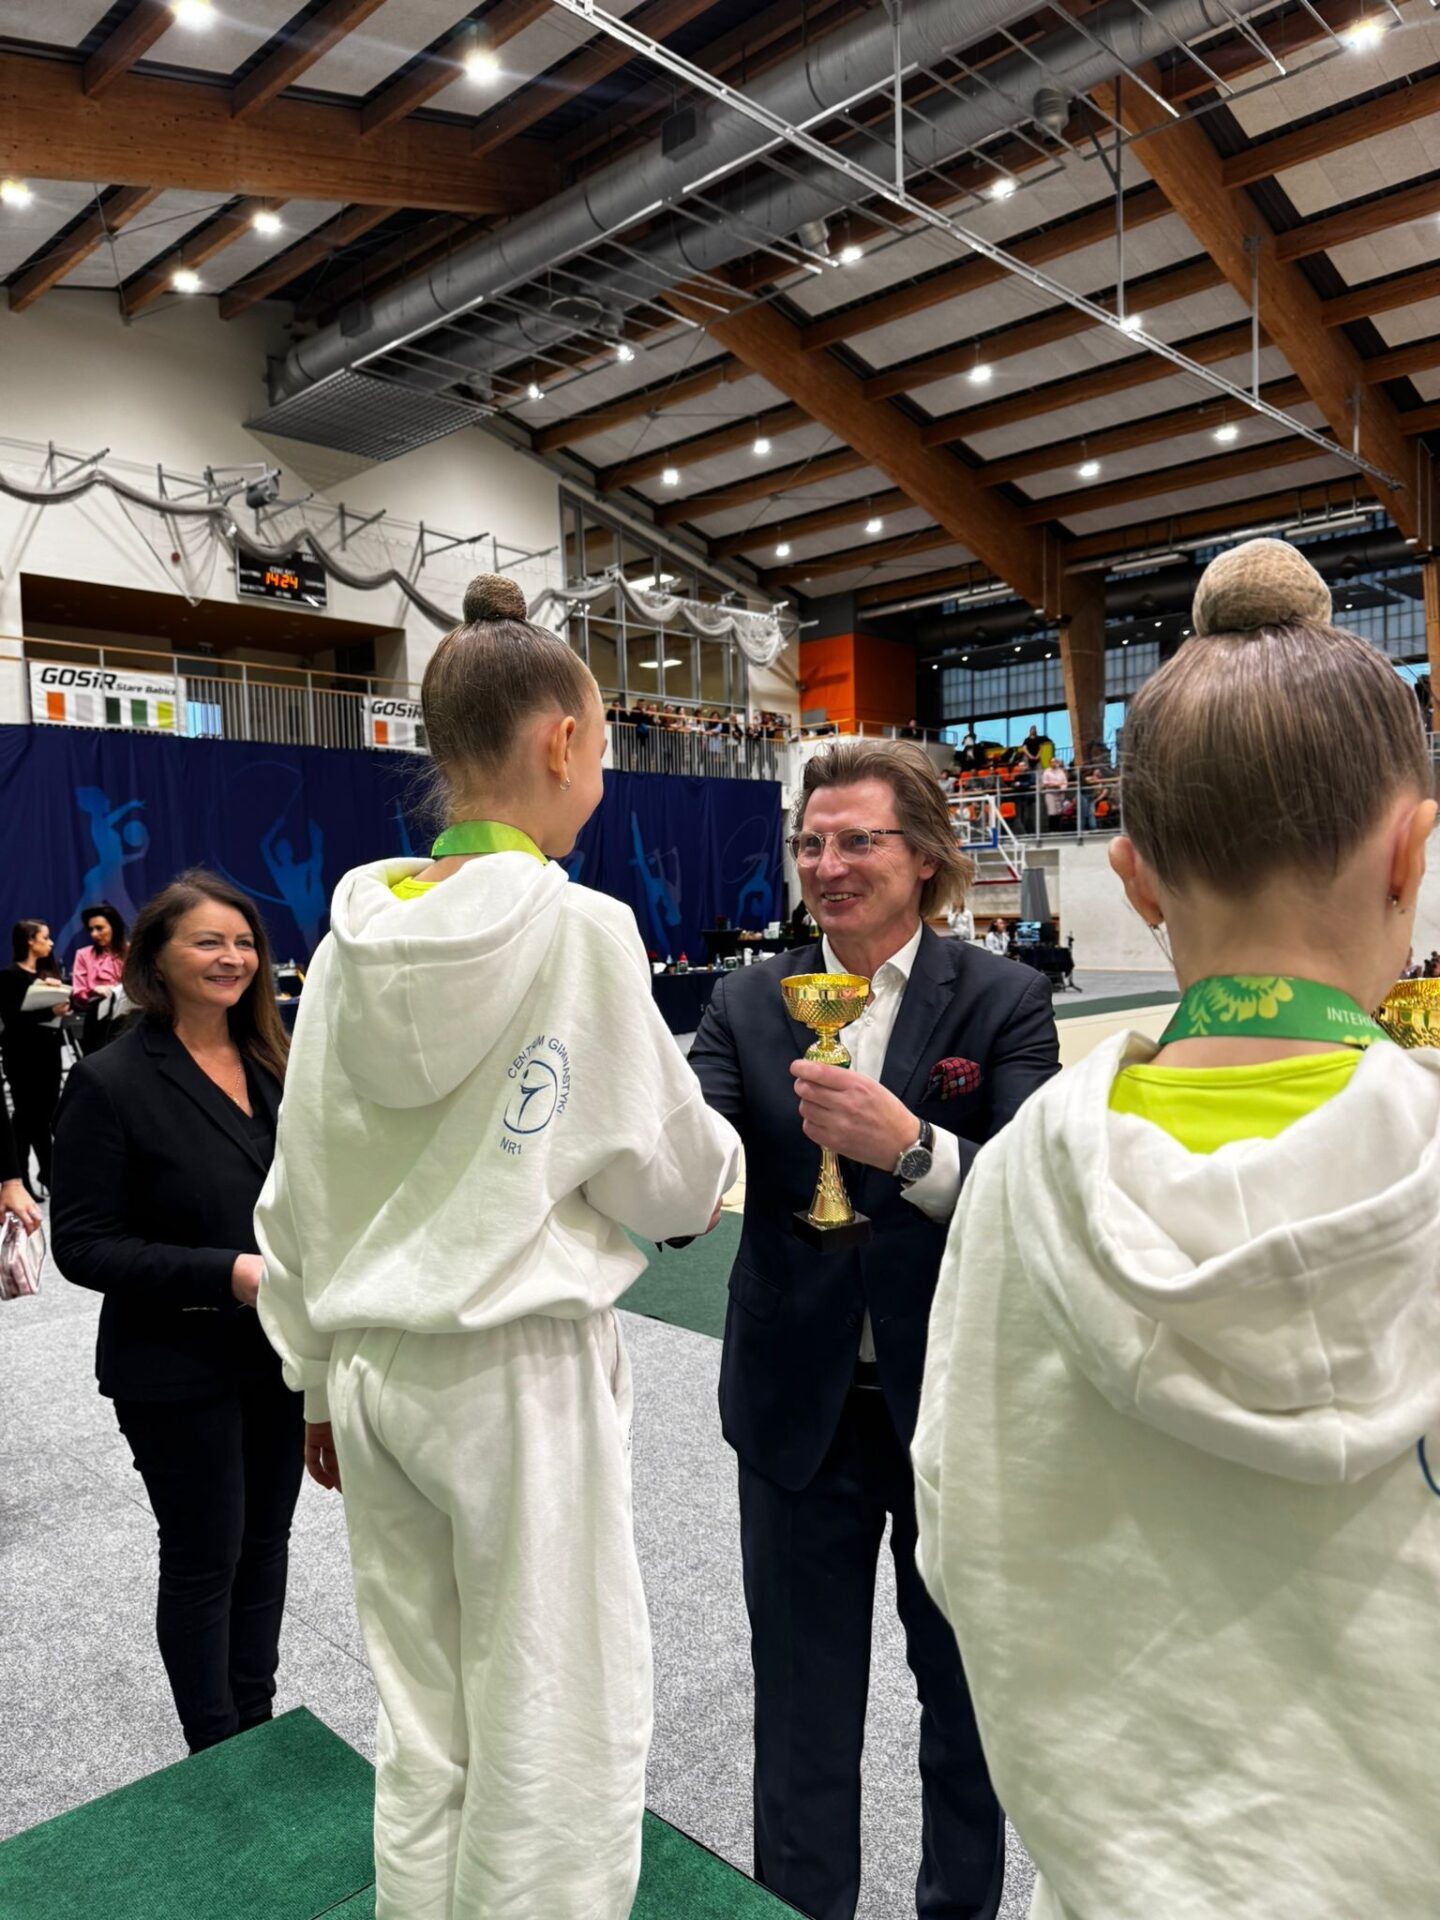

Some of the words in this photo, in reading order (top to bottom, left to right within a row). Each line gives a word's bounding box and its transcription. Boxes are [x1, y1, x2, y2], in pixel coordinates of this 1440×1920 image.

[41, 667, 117, 690] GOSiR
[115, 682, 143, 693] Stare
[499, 1137, 523, 1155] NR1
